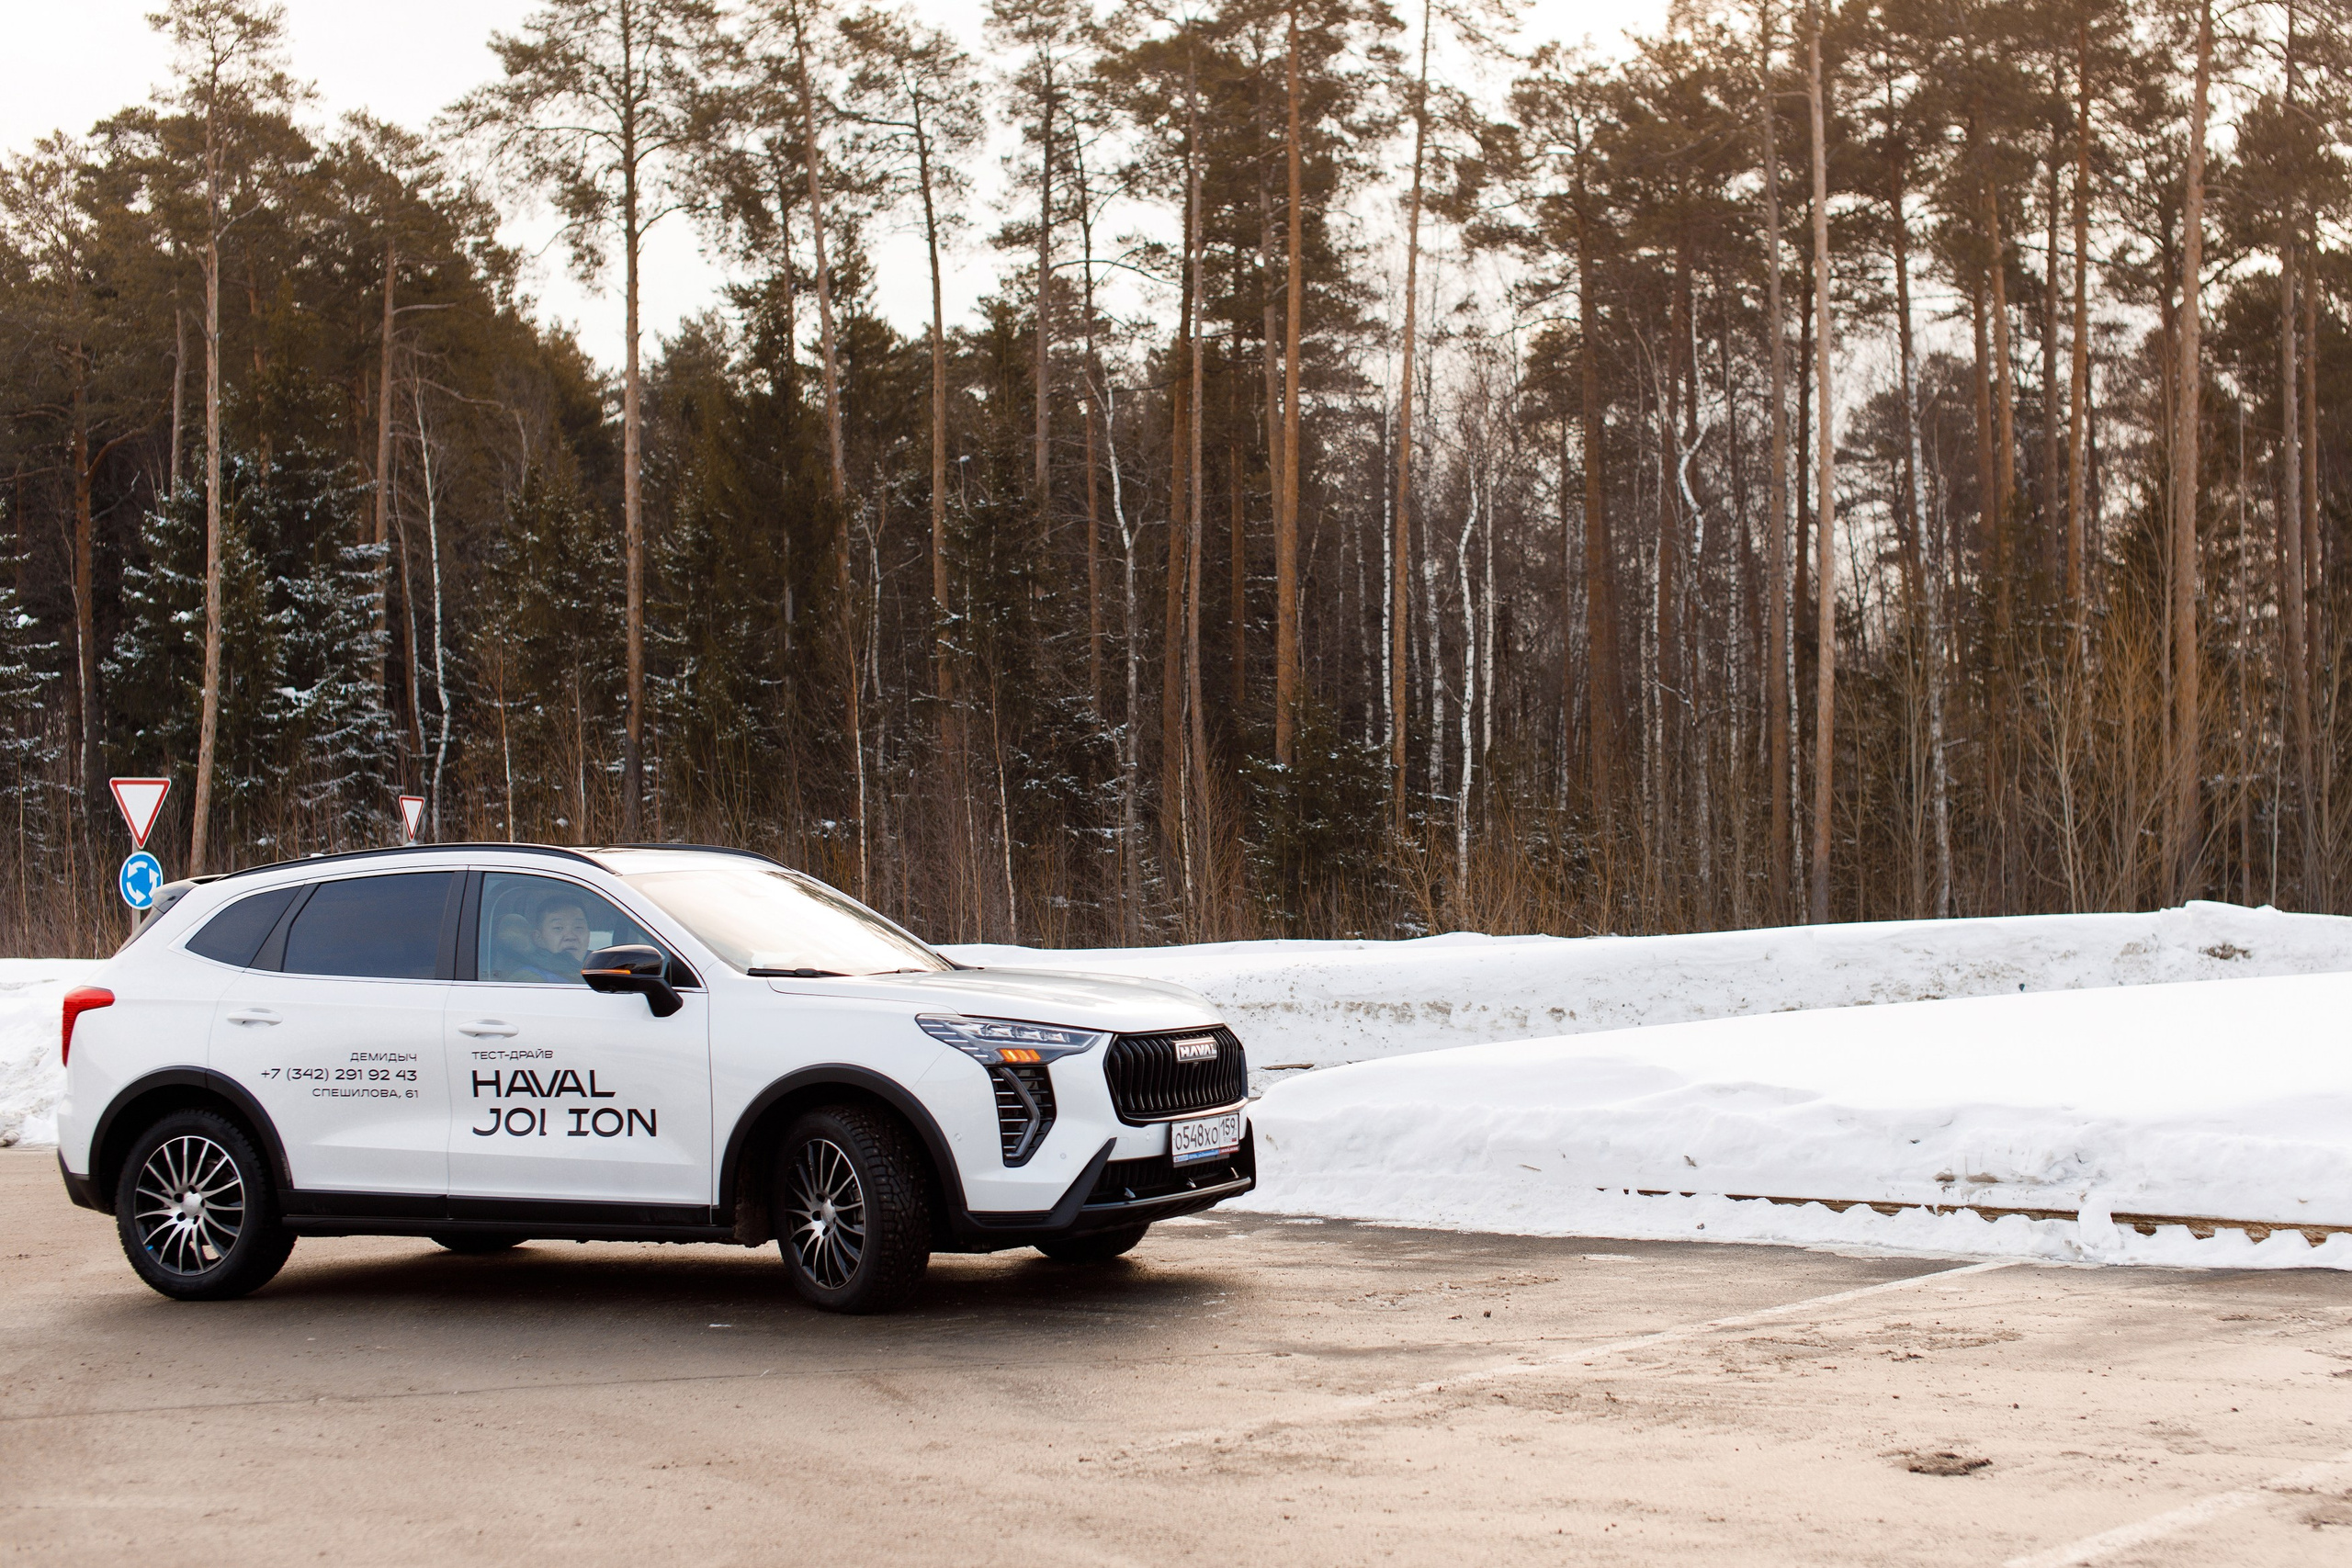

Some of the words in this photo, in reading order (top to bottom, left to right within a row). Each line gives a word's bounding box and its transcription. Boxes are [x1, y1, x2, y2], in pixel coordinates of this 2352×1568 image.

[471, 1048, 553, 1060] ТЕСТ-ДРАЙВ
[1180, 1043, 1216, 1057] HAVAL
[350, 1052, 417, 1063] ДЕМИДЫЧ
[261, 1068, 281, 1079] +7
[287, 1067, 329, 1081] (342)
[335, 1068, 362, 1080] 291
[368, 1069, 390, 1081] 92
[395, 1069, 417, 1081] 43
[472, 1070, 616, 1098] HAVAL
[312, 1088, 401, 1099] СПЕШИЛОВА,
[405, 1089, 419, 1099] 61
[1220, 1117, 1235, 1136] 159
